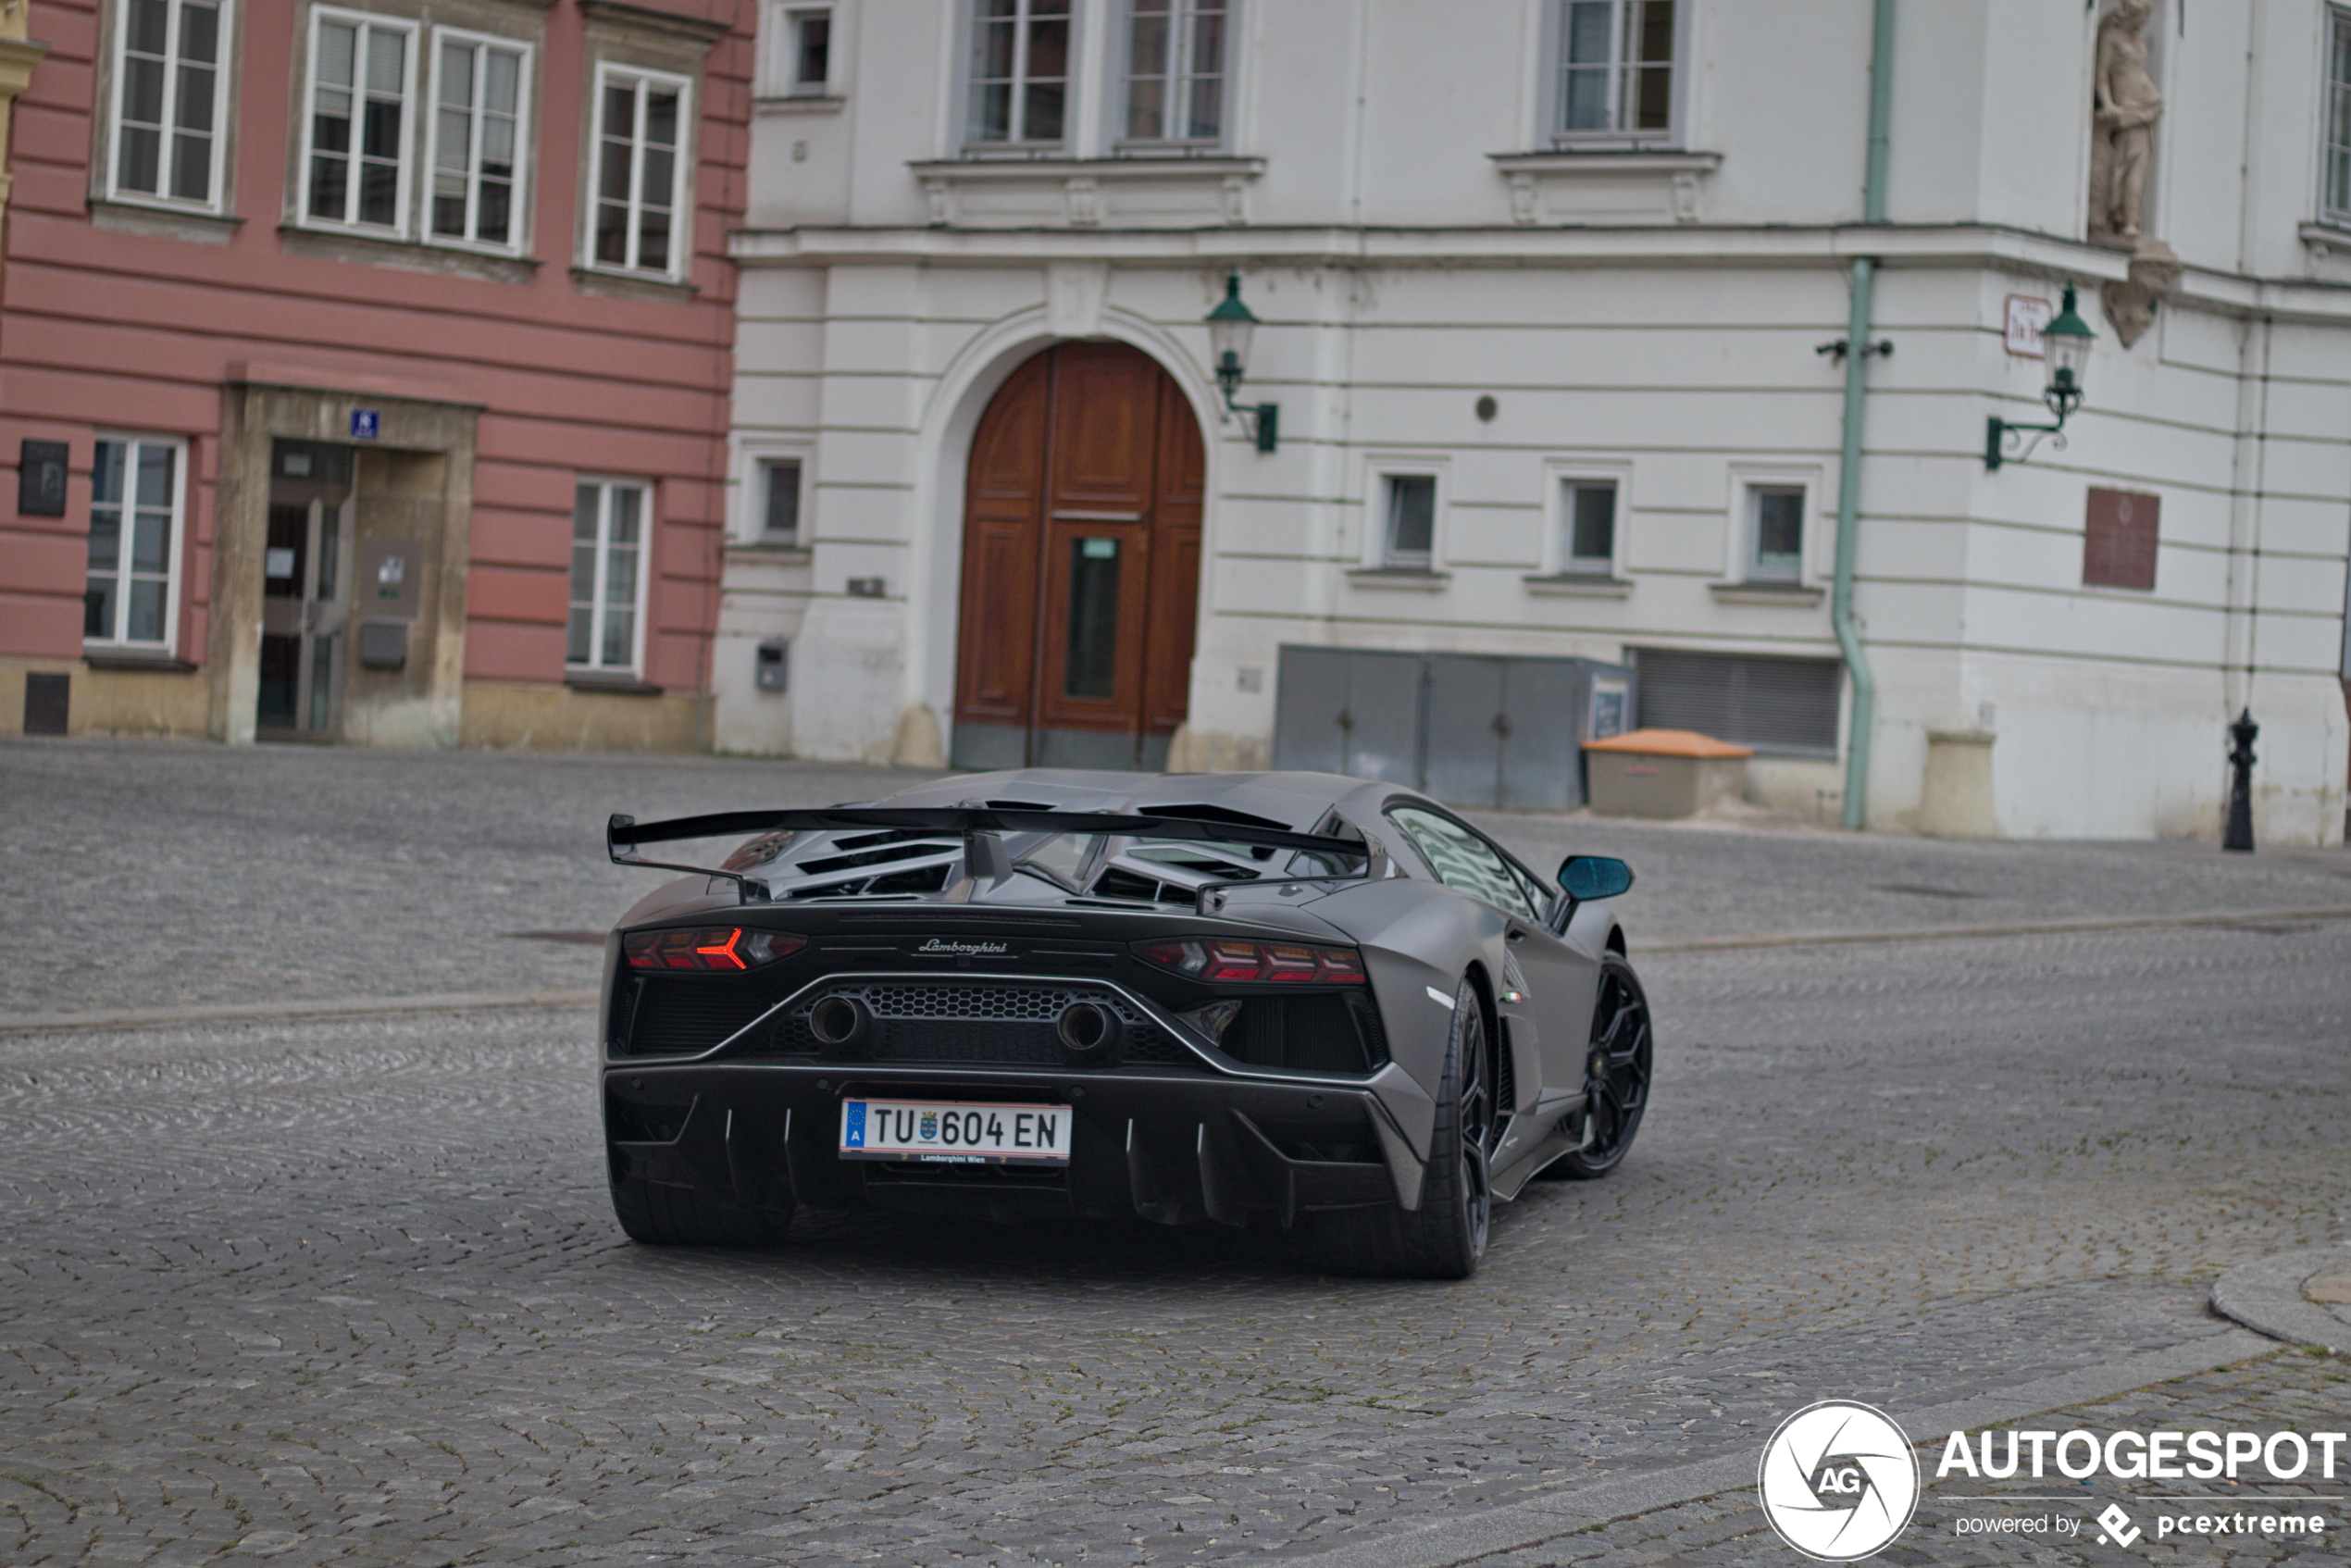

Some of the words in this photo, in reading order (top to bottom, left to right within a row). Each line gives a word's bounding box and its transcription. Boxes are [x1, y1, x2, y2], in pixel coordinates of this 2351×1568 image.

[918, 939, 1007, 955] Lamborghini
[875, 1109, 914, 1143] TU
[941, 1111, 1003, 1146] 604
[1014, 1114, 1056, 1148] EN
[851, 1130, 861, 1141] A
[921, 1154, 965, 1164] Lamborghini
